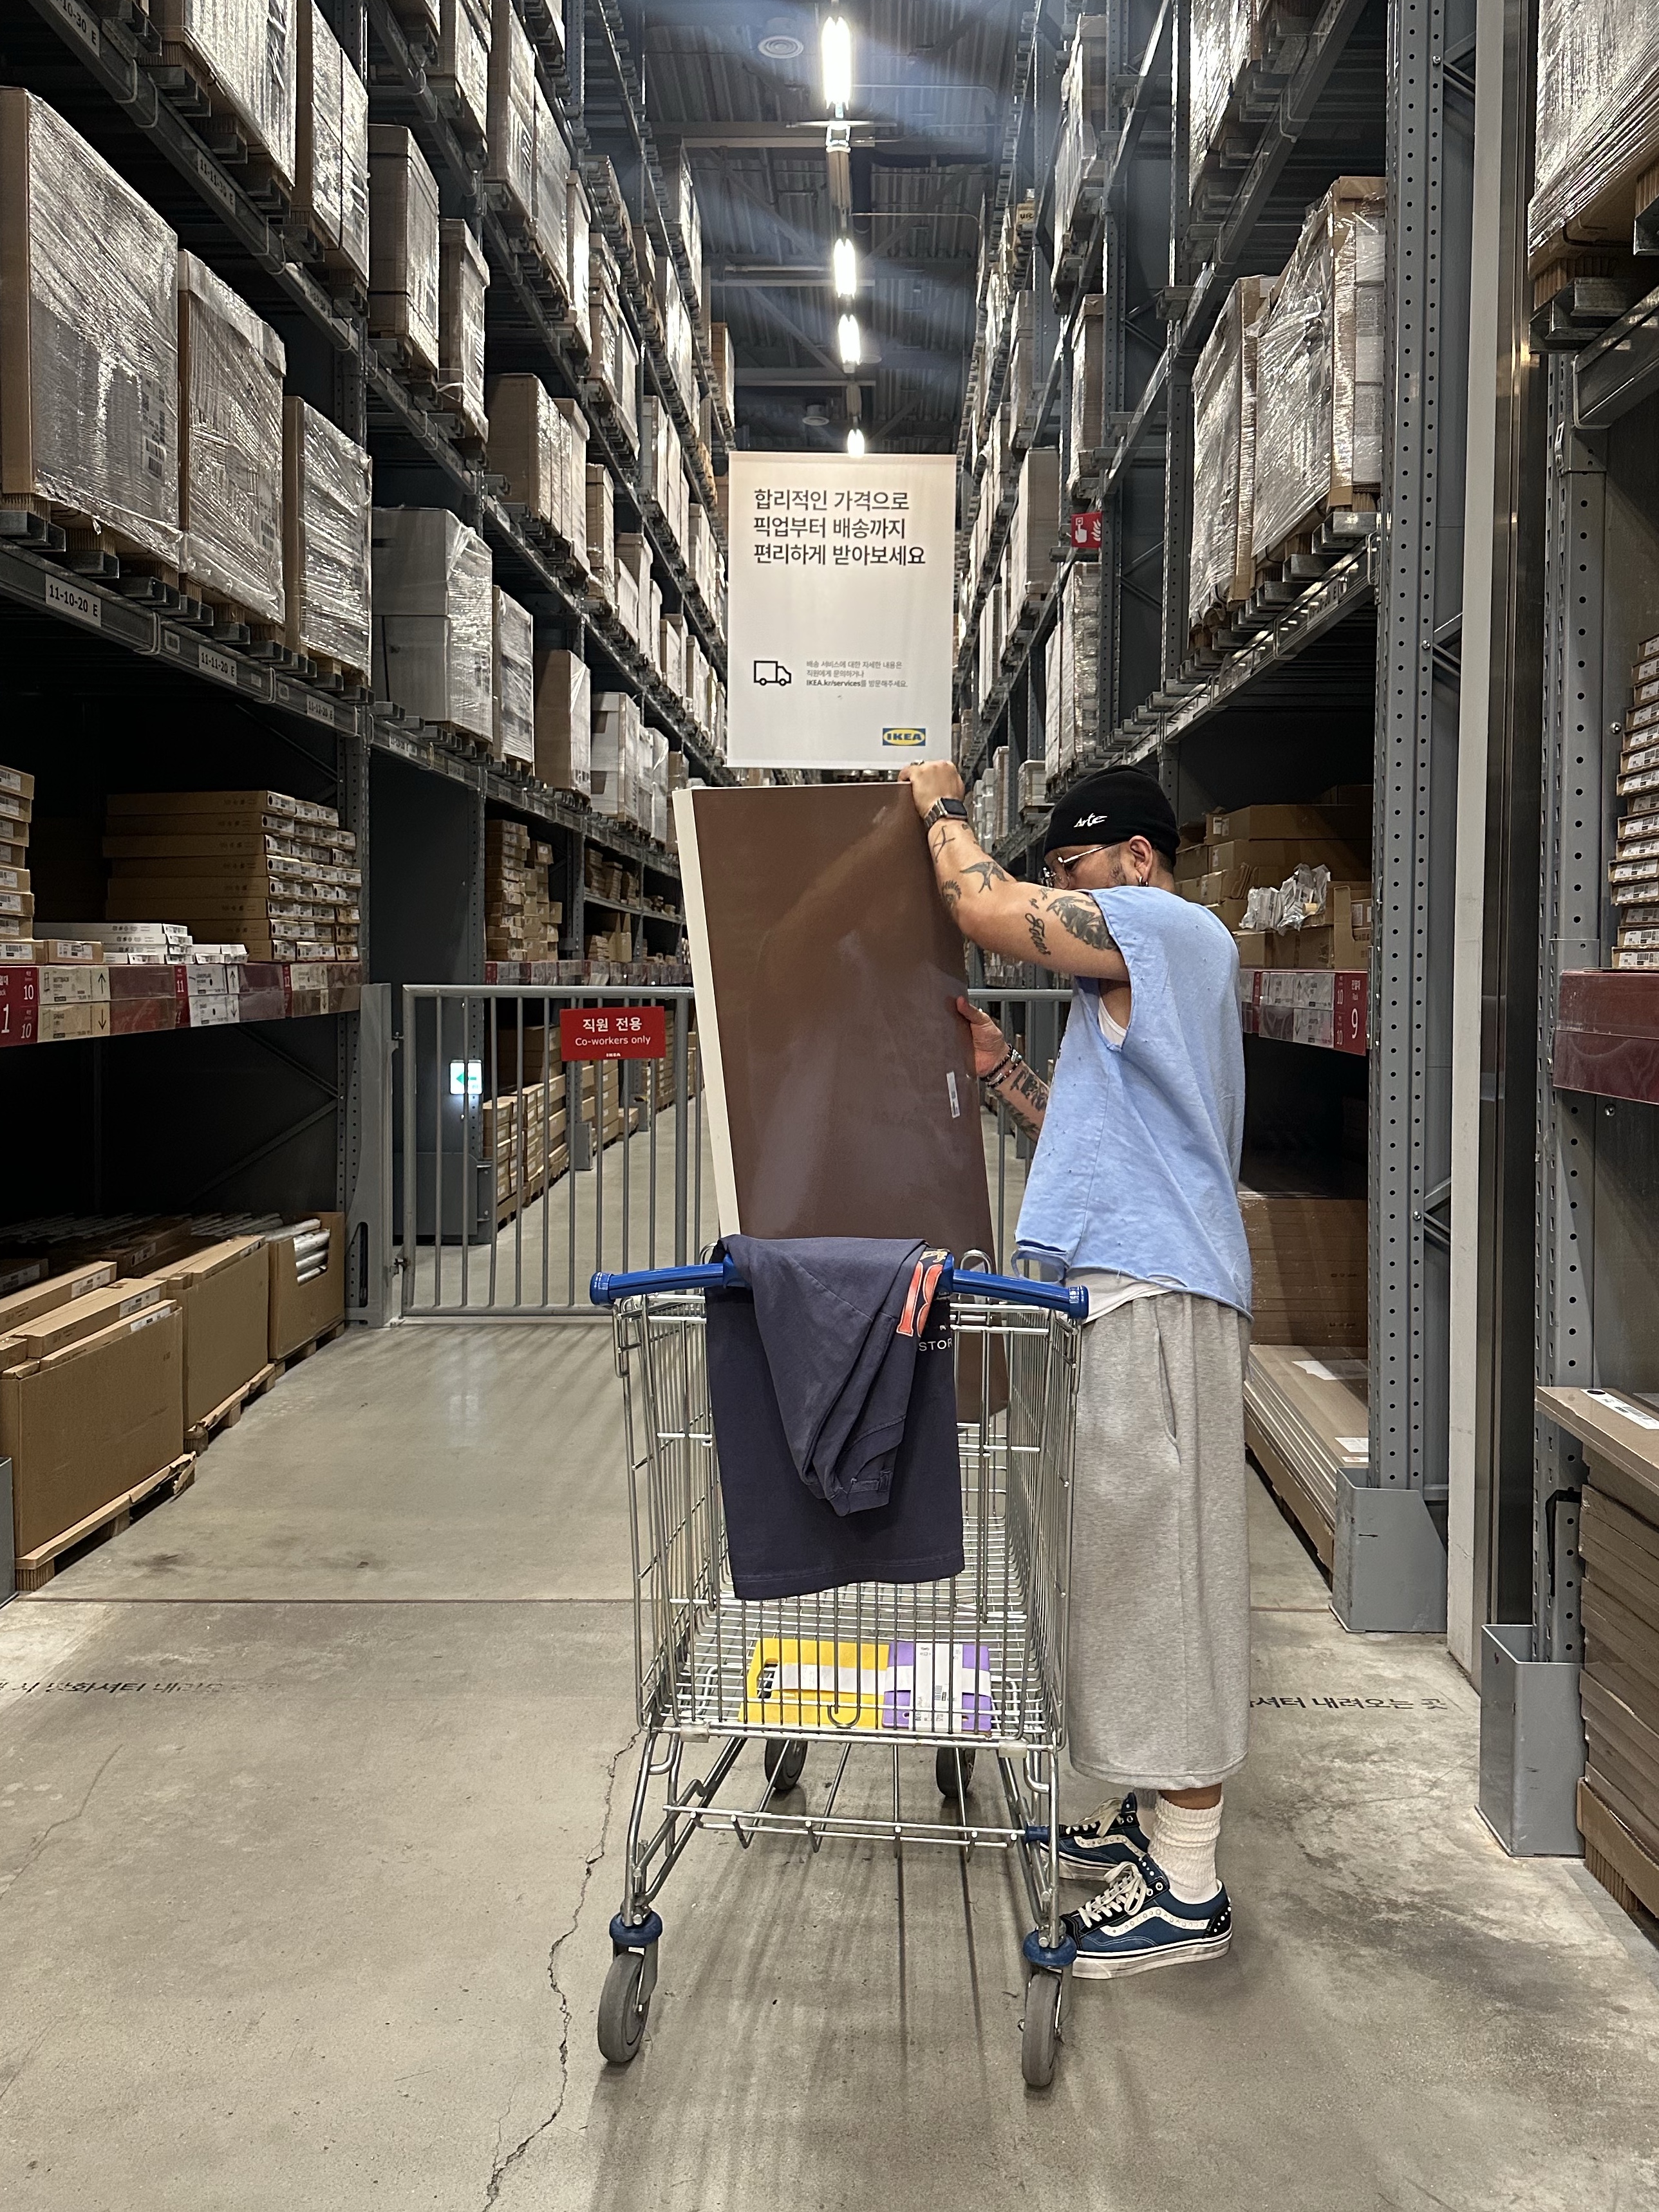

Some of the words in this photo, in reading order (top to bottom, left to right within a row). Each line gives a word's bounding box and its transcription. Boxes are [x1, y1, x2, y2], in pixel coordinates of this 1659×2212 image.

[91, 30, 97, 46] E
[754, 488, 827, 511] 합리적인
[834, 490, 909, 511] 가격으로
[754, 516, 825, 538] 픽업부터
[833, 518, 904, 539] 배송까지
[754, 543, 825, 565] 편리하게
[833, 545, 926, 566] 받아보세요
[50, 584, 88, 612] 11-10-20
[93, 604, 98, 617] E
[202, 652, 228, 674] 11-11-20
[231, 666, 235, 677] E
[1073, 813, 1108, 828] Arte
[24, 985, 34, 999] 10
[176, 980, 184, 992] 11
[1337, 989, 1344, 1005] 10
[1, 1003, 10, 1033] 1
[583, 1018, 609, 1032] 직원
[615, 1017, 642, 1032] 전용
[1351, 1008, 1358, 1039] 9
[21, 1023, 32, 1038] 10
[1336, 1030, 1344, 1045] 10
[575, 1037, 628, 1046] Co-workers
[631, 1035, 651, 1045] only
[1250, 1696, 1307, 1708] 셔터
[1311, 1697, 1414, 1709] 내려오는
